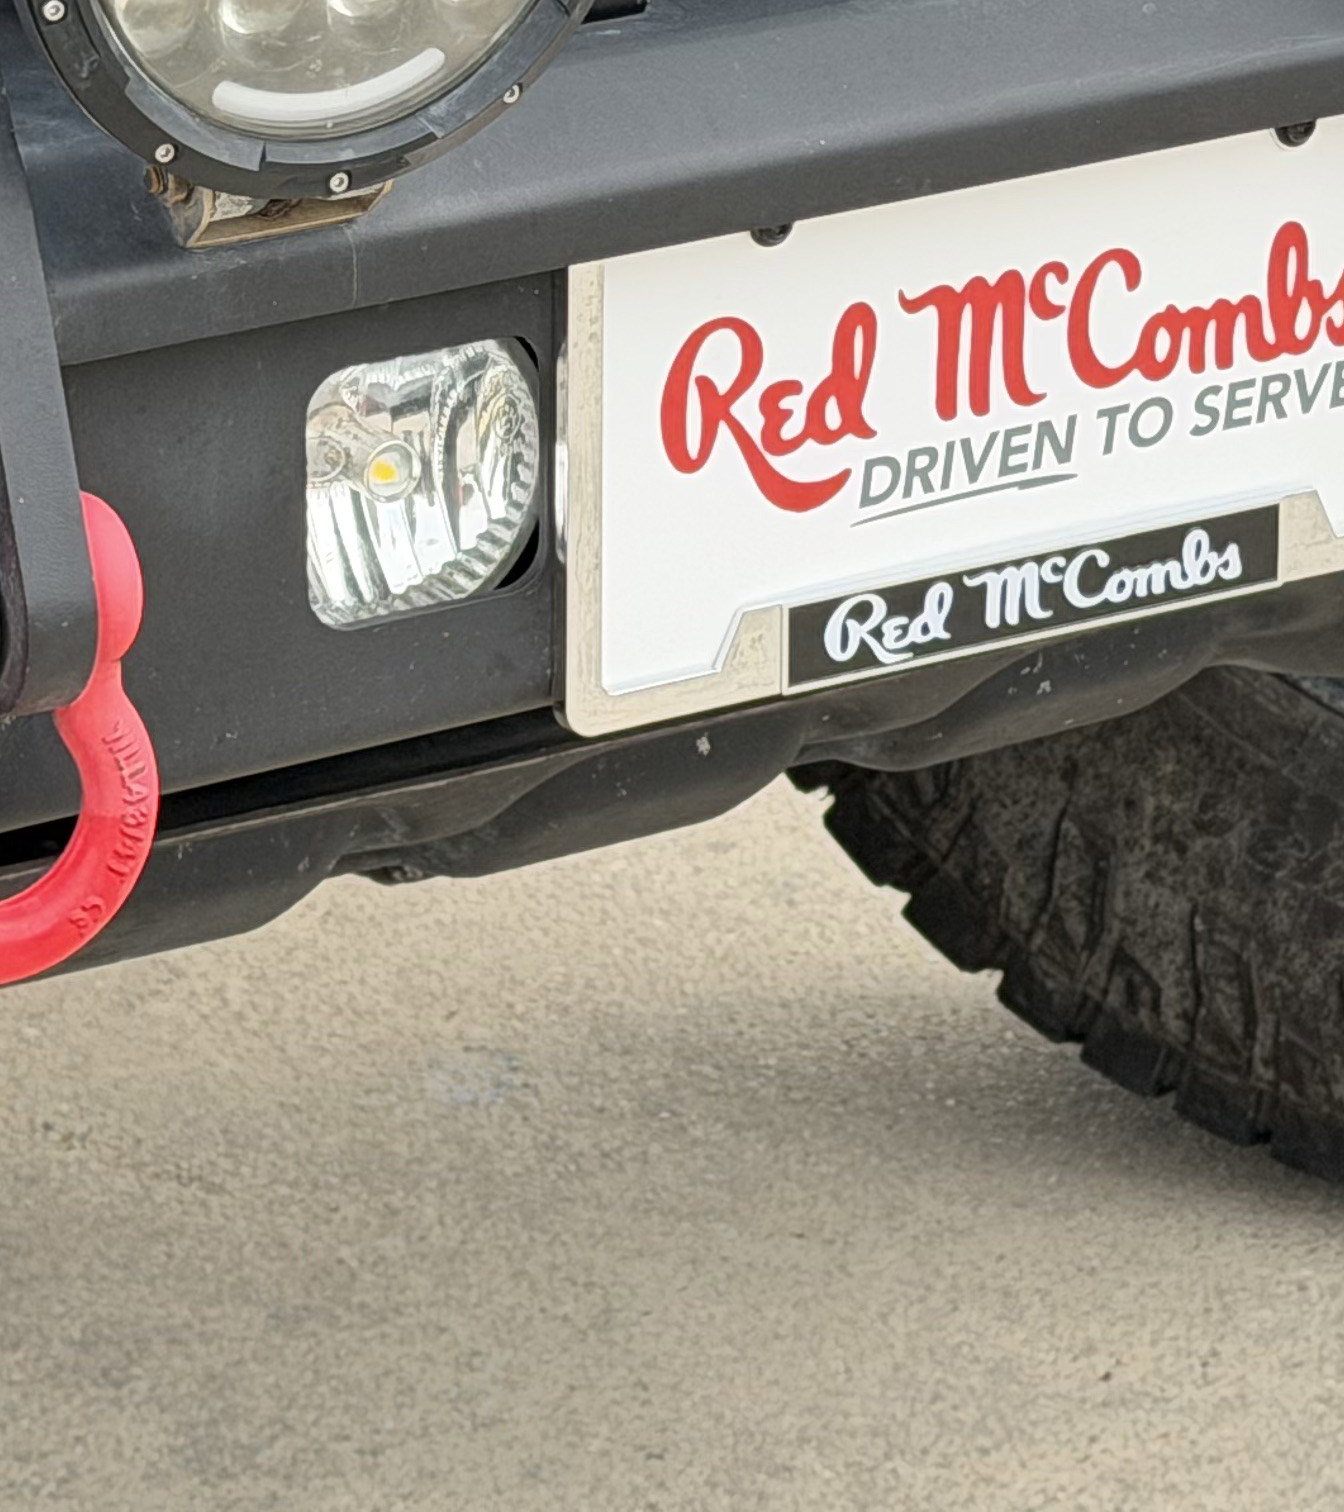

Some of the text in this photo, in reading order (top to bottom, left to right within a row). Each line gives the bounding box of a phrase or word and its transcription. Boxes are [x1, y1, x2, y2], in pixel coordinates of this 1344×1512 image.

[660, 300, 879, 513] Red
[859, 413, 1078, 509] DRIVEN
[1097, 396, 1175, 457] TO
[823, 527, 1244, 666] Red McCombs
